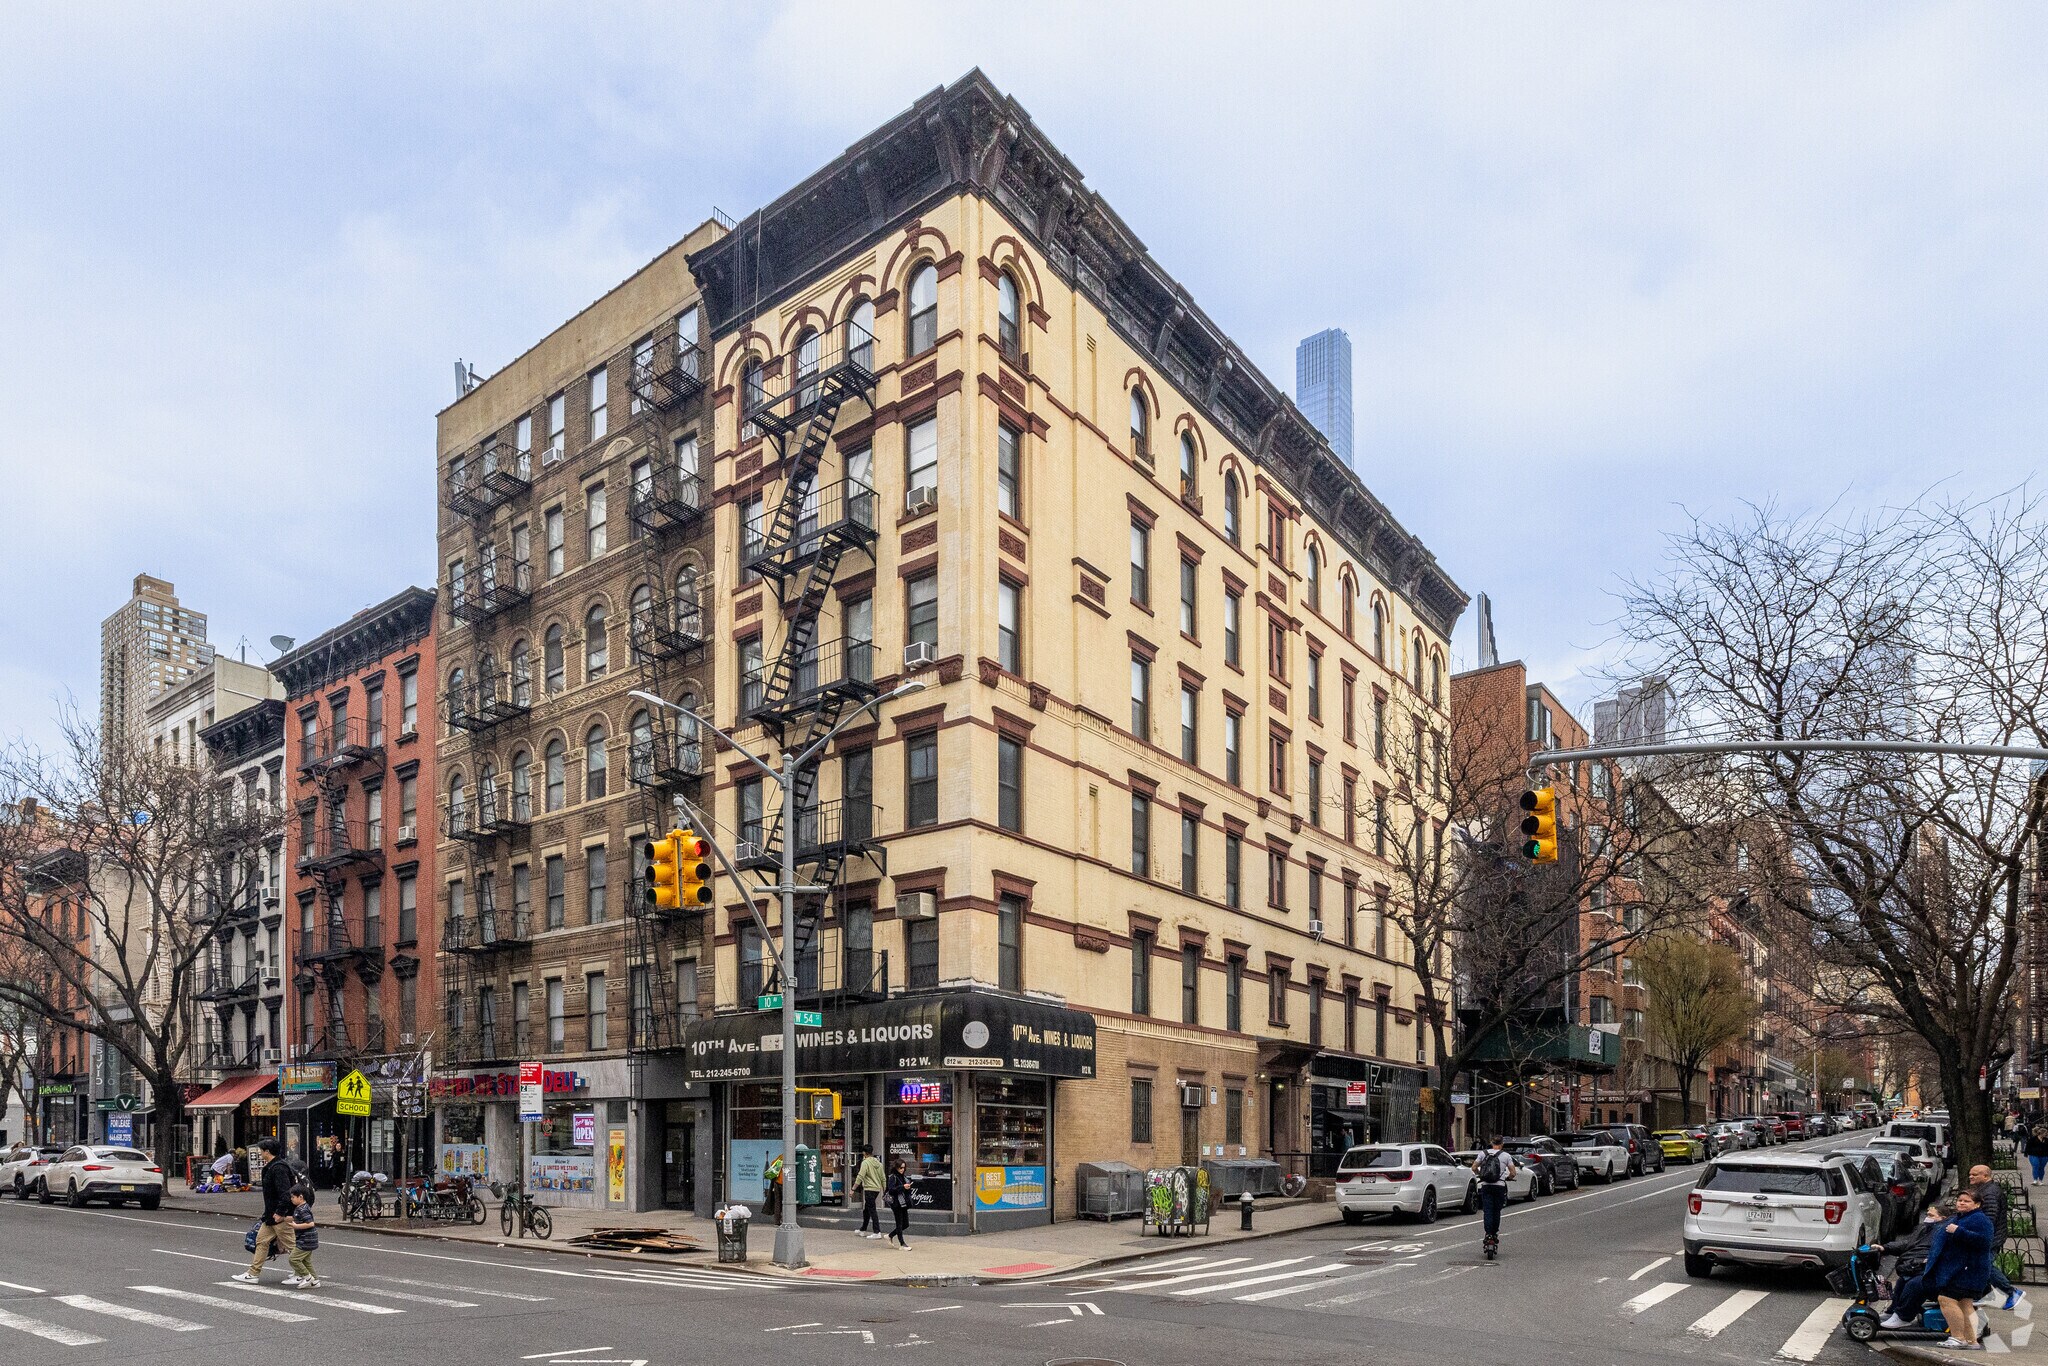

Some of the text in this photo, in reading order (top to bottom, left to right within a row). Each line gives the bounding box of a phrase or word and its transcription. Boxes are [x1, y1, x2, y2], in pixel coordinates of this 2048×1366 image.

[764, 998, 772, 1008] 10
[795, 1013, 801, 1023] W
[804, 1014, 813, 1024] 54
[691, 1040, 724, 1056] 10TH
[796, 1030, 843, 1048] WINES
[847, 1029, 858, 1044] &
[861, 1023, 934, 1043] LIQUORS
[1012, 1024, 1027, 1041] 10TH
[1043, 1029, 1061, 1047] WINES
[1064, 1032, 1069, 1047] &
[1071, 1033, 1093, 1050] LIQUORS
[899, 1056, 931, 1067] 812 W.
[968, 1058, 1001, 1066] 212-245-6700
[690, 1068, 751, 1078] TEL. 212-245-6700
[497, 1073, 520, 1095] STA
[543, 1070, 576, 1092] DELI
[901, 1083, 940, 1103] OPEN
[120, 1099, 131, 1109] V
[340, 1103, 368, 1113] SCHOOL
[576, 1127, 594, 1140] OPEN
[985, 1172, 1001, 1181] BEST
